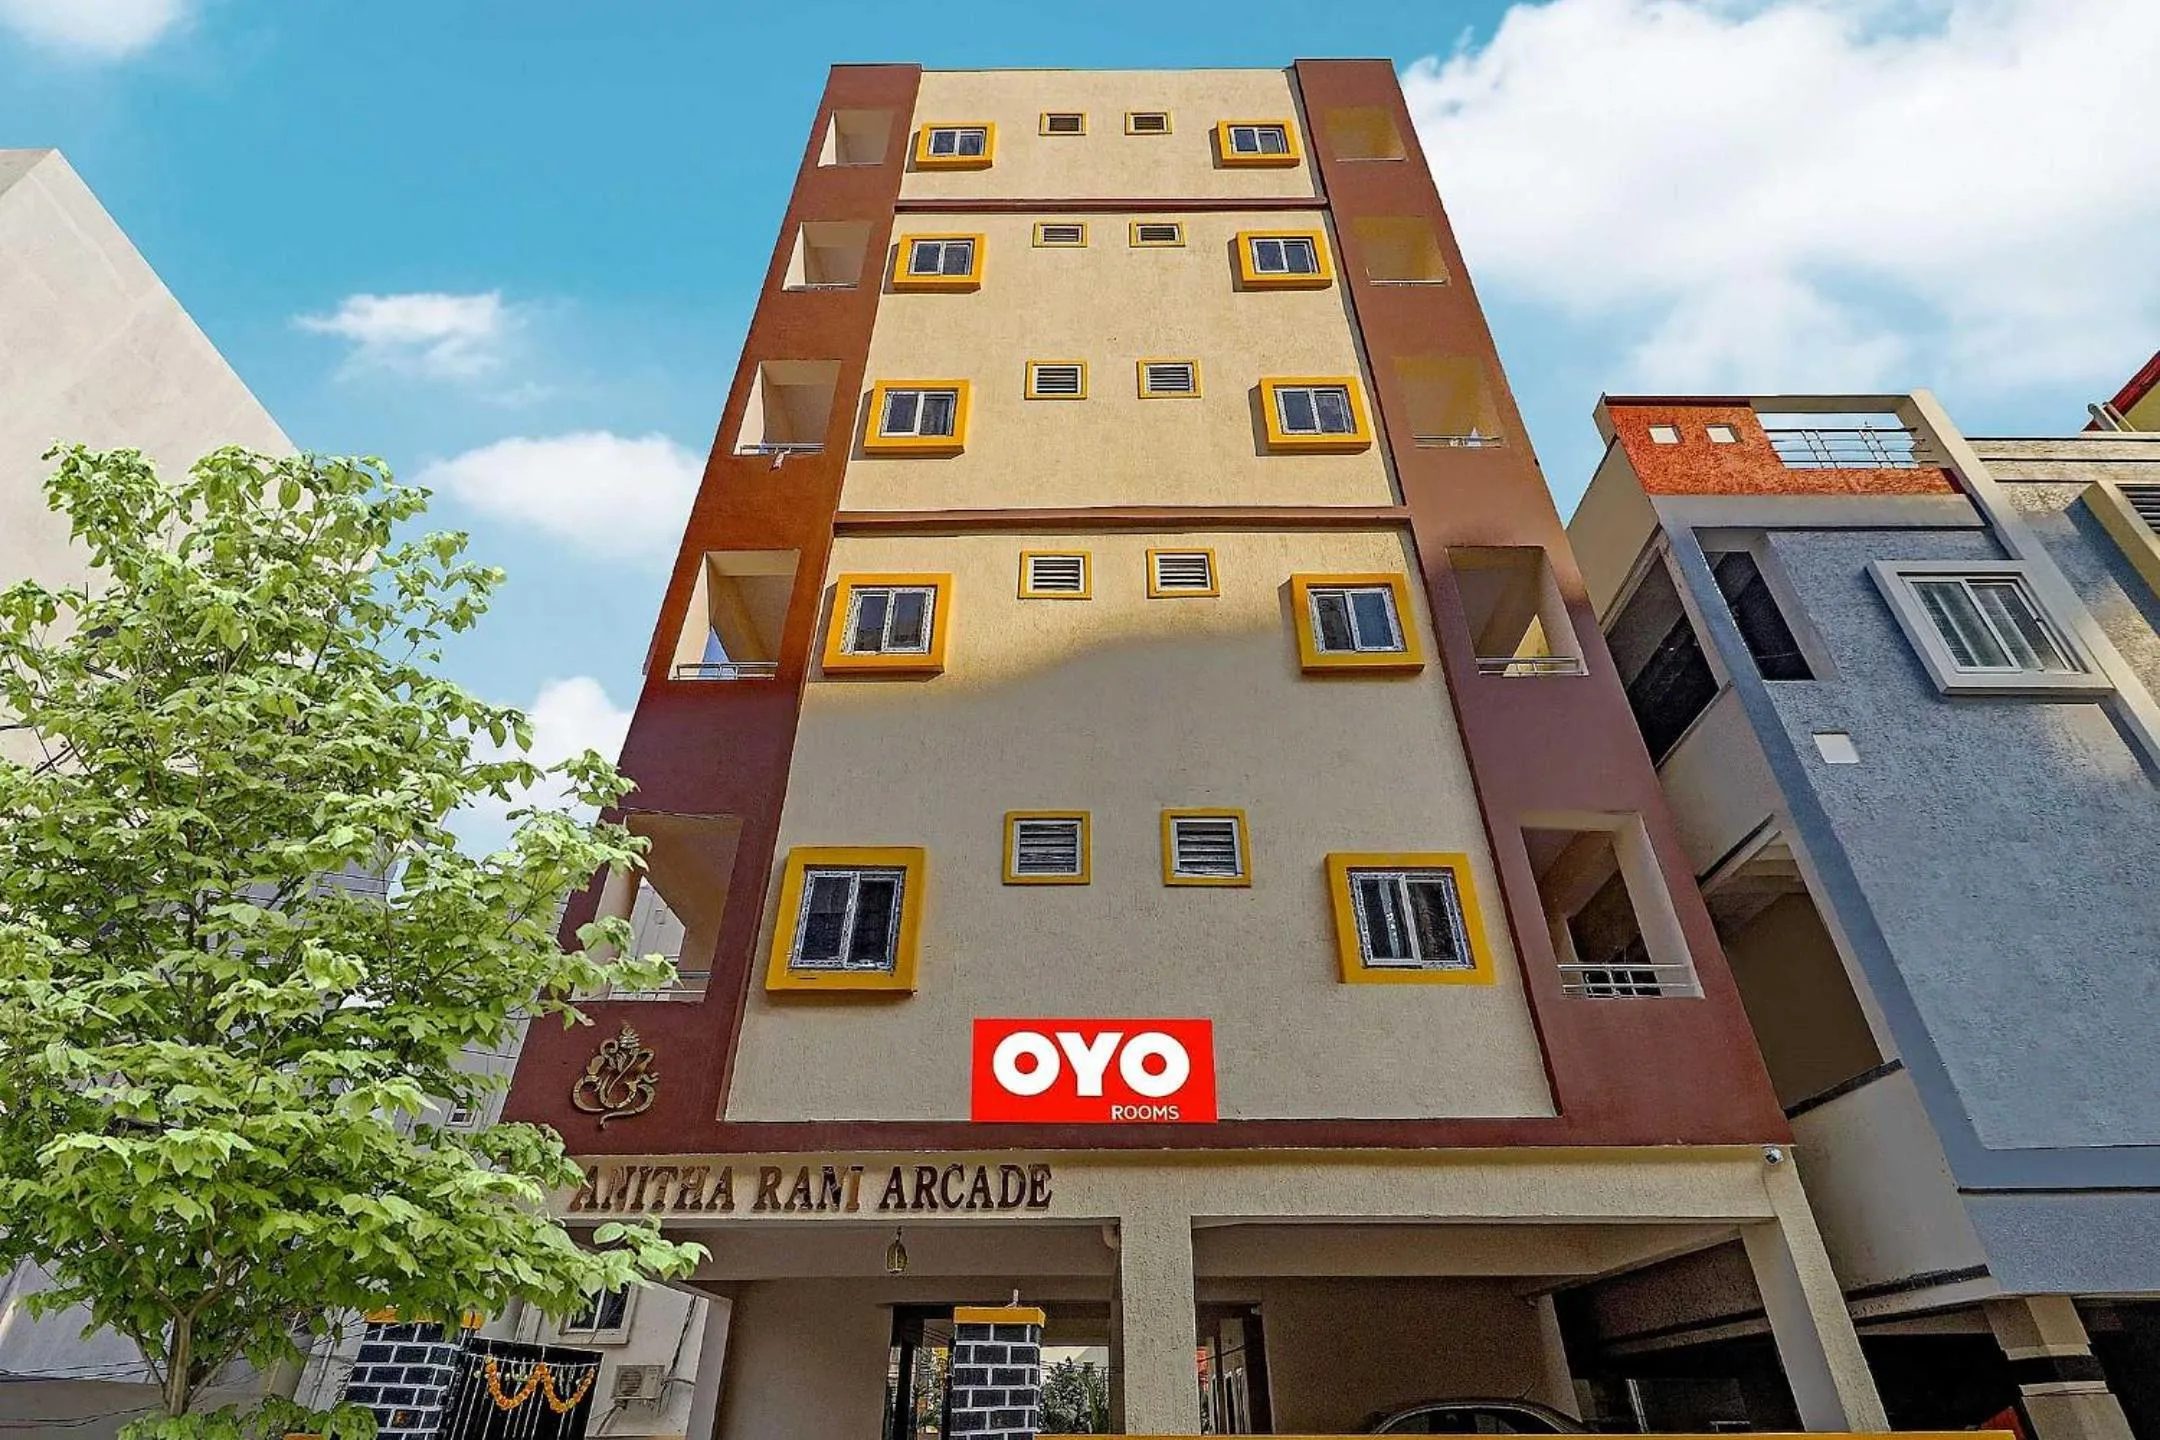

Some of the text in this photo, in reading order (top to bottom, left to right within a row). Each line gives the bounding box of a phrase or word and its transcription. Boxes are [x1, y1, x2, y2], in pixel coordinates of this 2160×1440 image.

[992, 1031, 1191, 1097] OYO
[1111, 1105, 1180, 1120] ROOMS
[568, 1163, 1053, 1212] ANITHA RANI ARCADE
